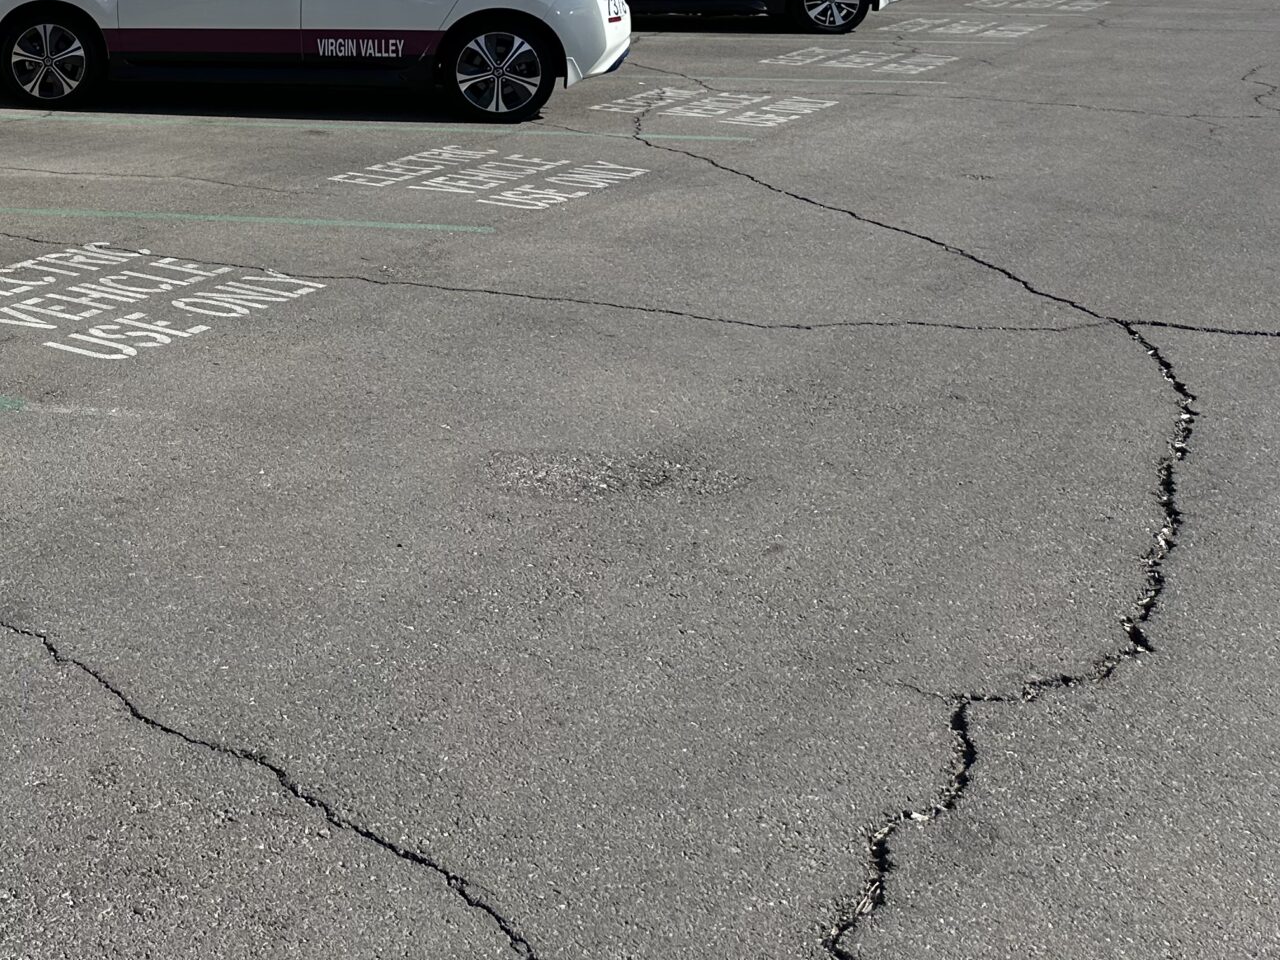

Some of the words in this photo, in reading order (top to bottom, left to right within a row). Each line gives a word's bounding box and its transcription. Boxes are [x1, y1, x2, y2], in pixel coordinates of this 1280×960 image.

[317, 38, 356, 57] VIRGIN
[359, 38, 404, 57] VALLEY
[327, 145, 499, 187] ELECTRIC
[406, 154, 573, 194] VEHICLE
[476, 183, 590, 210] USE
[555, 160, 652, 189] ONLY
[42, 312, 212, 360] USE
[171, 268, 327, 317] ONLY
